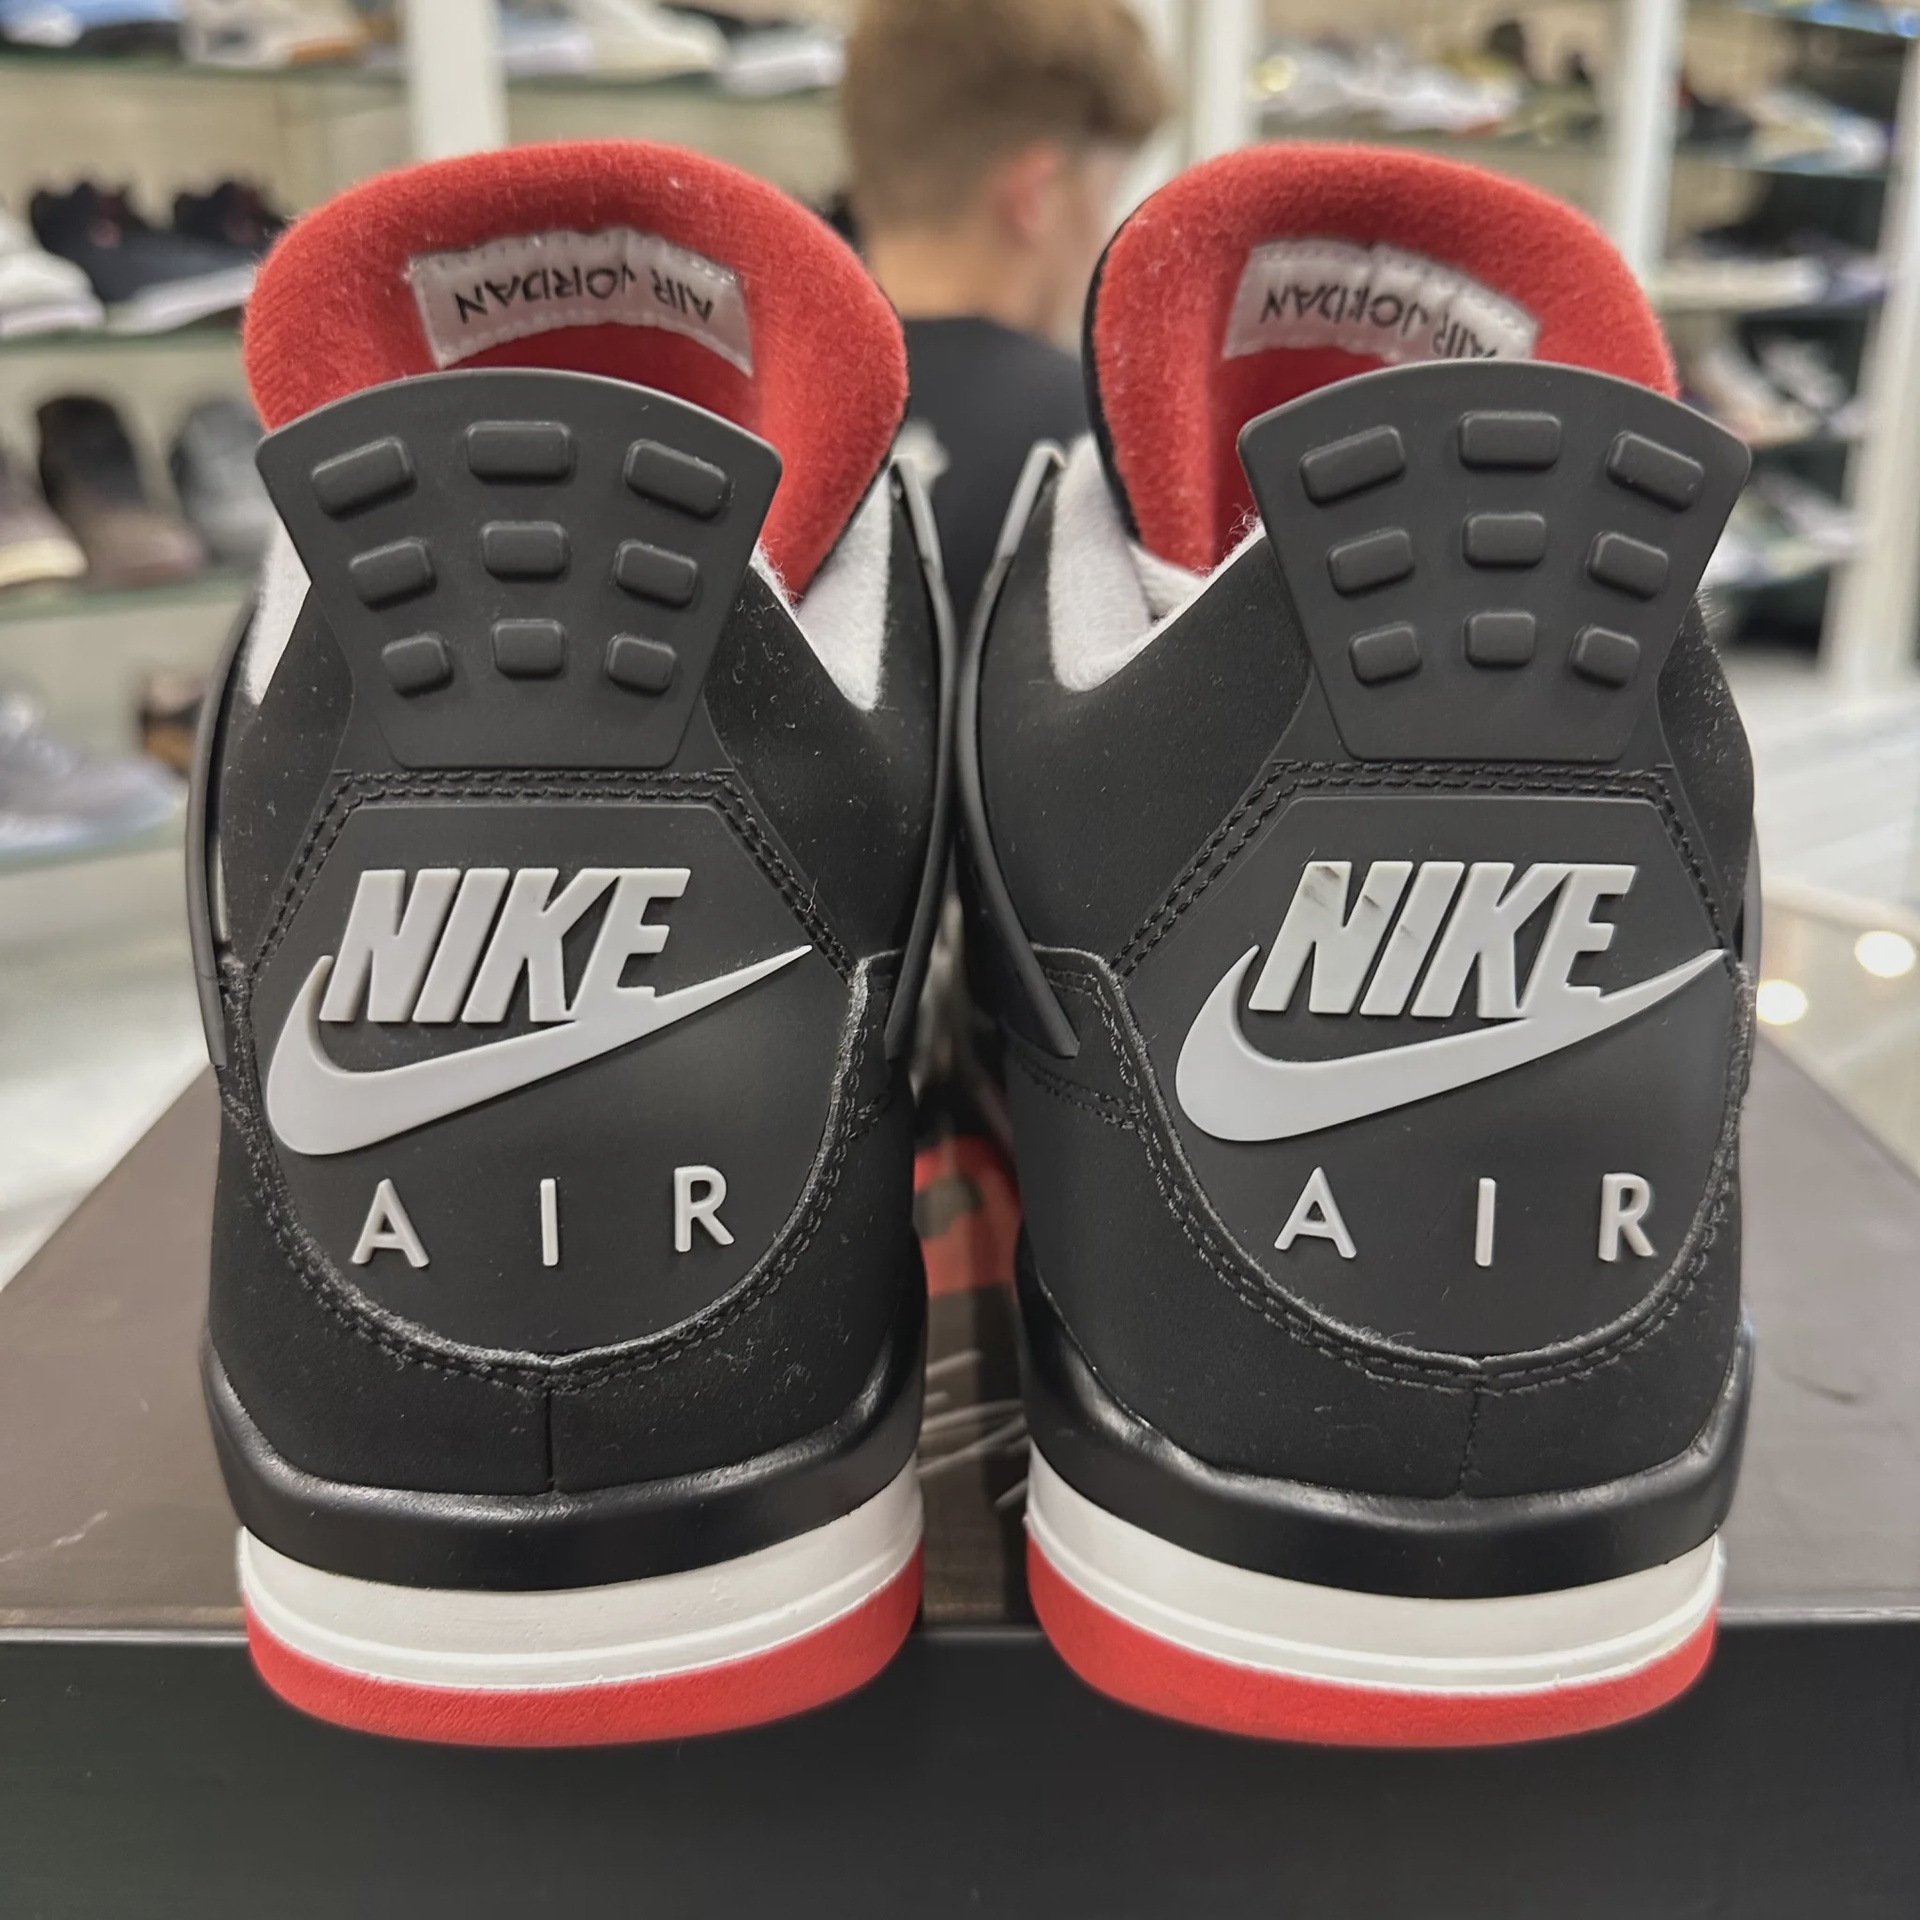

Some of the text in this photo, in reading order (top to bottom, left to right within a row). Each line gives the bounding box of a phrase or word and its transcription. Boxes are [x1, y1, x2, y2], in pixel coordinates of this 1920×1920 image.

[454, 263, 713, 324] AIR JORDAN
[1259, 284, 1429, 337] JORDAN
[319, 867, 692, 1022] NIKE
[1248, 860, 1637, 1019] NIKE
[351, 1164, 735, 1268] AIR
[1273, 1166, 1658, 1268] AIR
